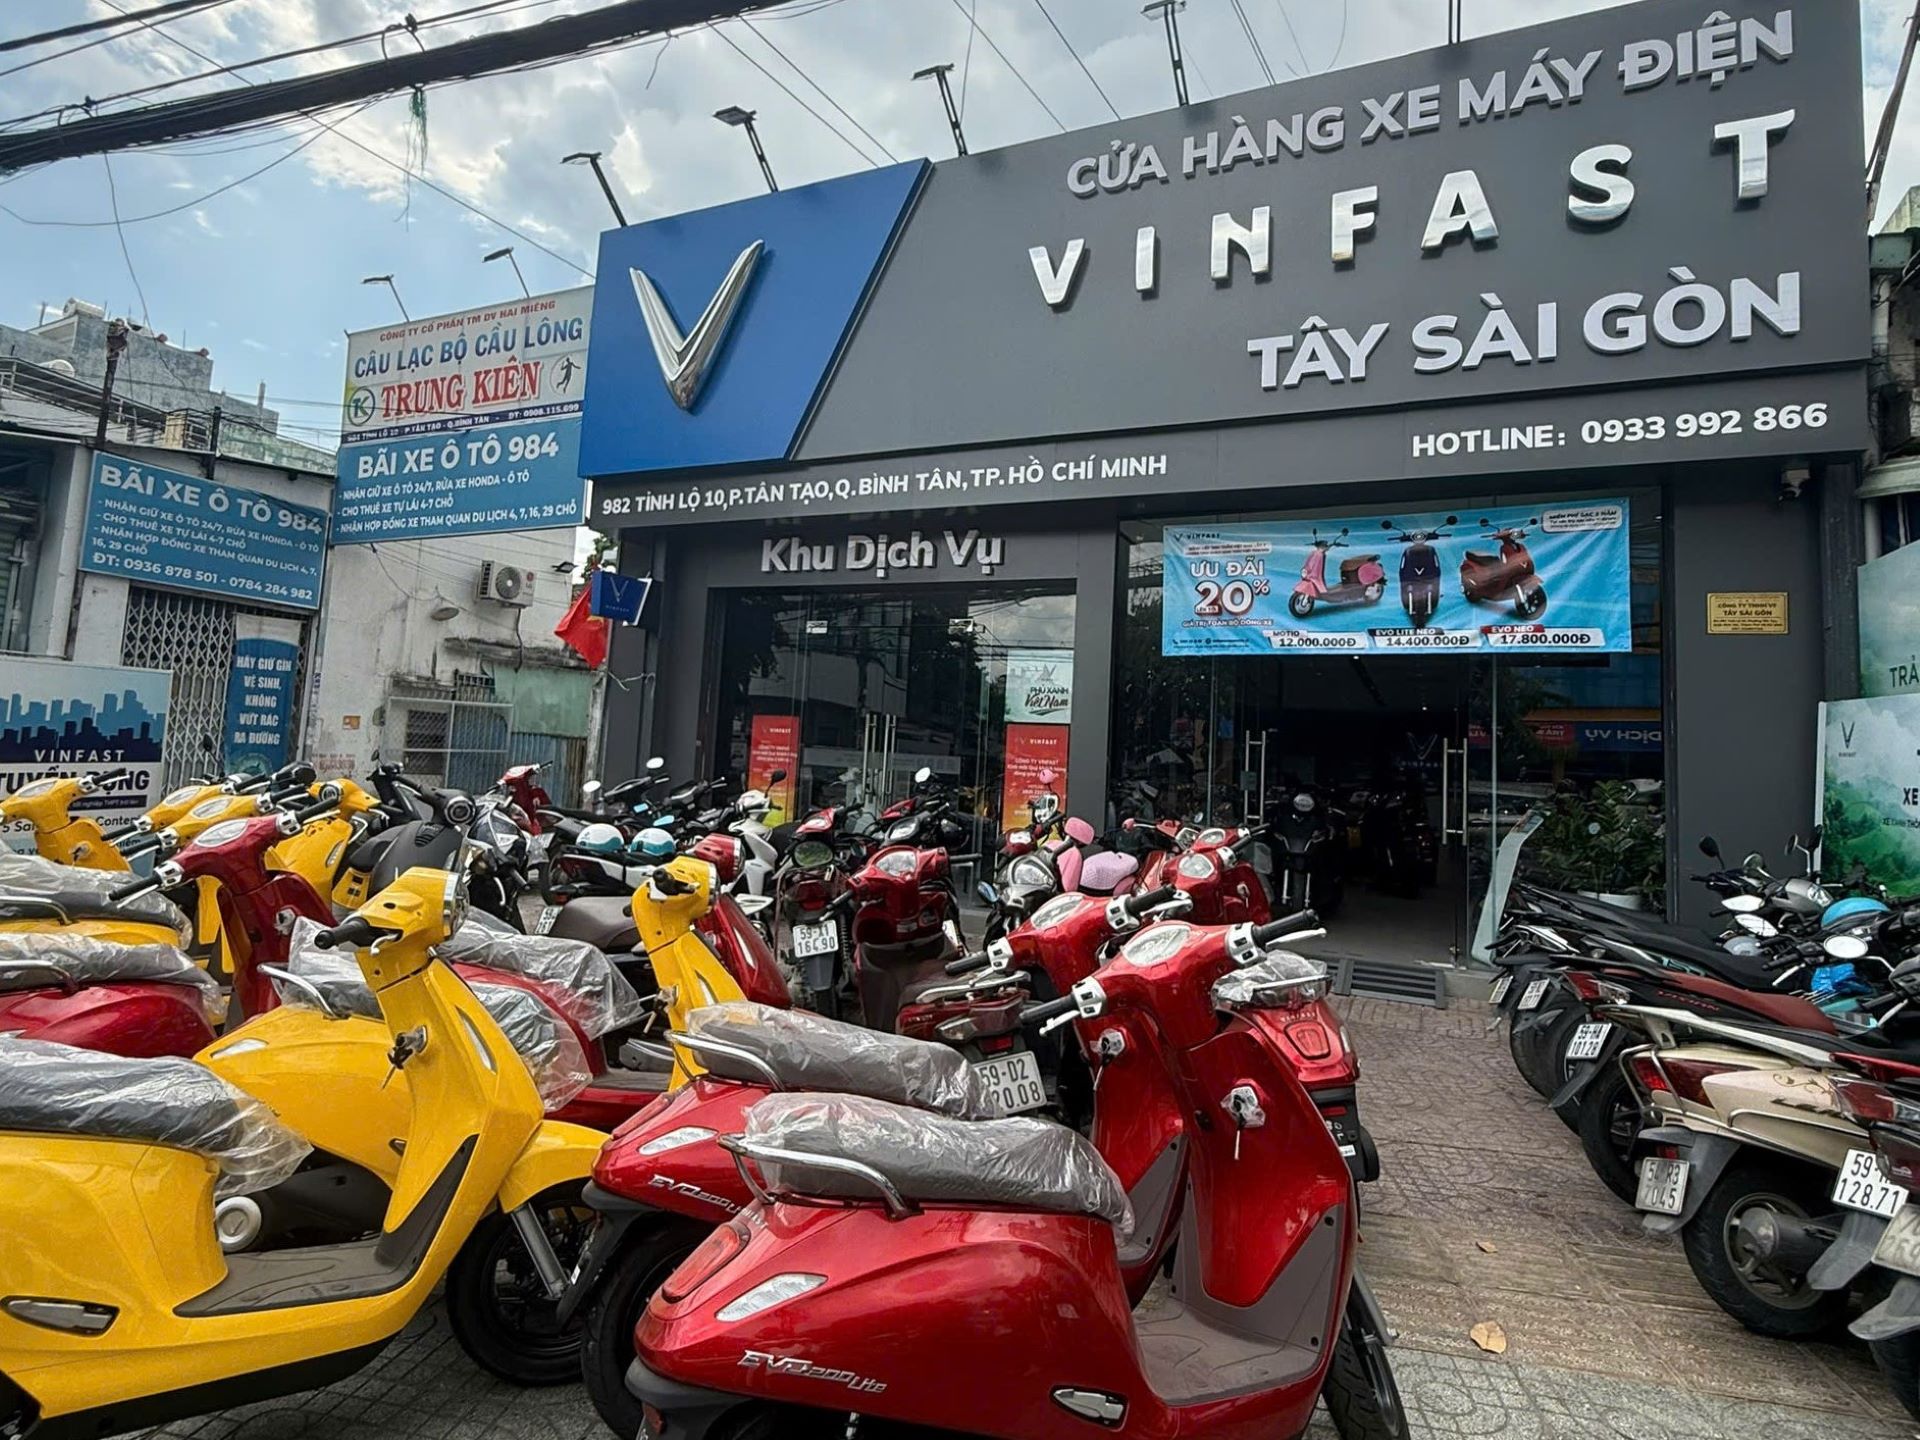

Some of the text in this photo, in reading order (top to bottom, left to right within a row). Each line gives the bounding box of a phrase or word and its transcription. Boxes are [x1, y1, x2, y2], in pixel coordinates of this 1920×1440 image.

[1067, 10, 1793, 198] CỬA HÀNG XE MÁY ĐIỆN
[1029, 109, 1796, 306] VINFAST
[408, 327, 418, 336] TY
[467, 315, 481, 325] TM
[1247, 266, 1800, 390] TÂY SÀI GÒN
[355, 317, 582, 378] CÂU LẠC BỘ CẦU LÔNG
[381, 355, 541, 419] TRUNG KIÊN
[1412, 402, 1828, 457] HOTLINE: 0933 992 866
[358, 432, 559, 479] BÃI XE Ô TÔ 984
[100, 464, 322, 534] BÃI XE Ô TÔ 984
[381, 485, 392, 496] XE
[455, 478, 466, 489] XE
[468, 475, 500, 487] HONDA
[601, 454, 1167, 515] 982 TỈNH LỘ CHÍ MINH
[104, 499, 137, 514] NHẬN
[160, 512, 174, 521] XE
[186, 516, 200, 527] TÔ
[247, 530, 260, 541] XE
[262, 533, 293, 547] HONDA
[341, 507, 359, 517] CHO
[381, 503, 392, 513] XE
[420, 499, 434, 509] 4-7
[407, 517, 419, 527] XE
[420, 515, 444, 526] THAM
[445, 512, 470, 526] QUAN
[472, 512, 486, 522] DU
[487, 509, 508, 523] LỊCH
[519, 508, 528, 520] 7,
[529, 507, 541, 519] 16,
[542, 505, 554, 517] 29
[103, 512, 128, 524] CHO
[160, 525, 174, 534] XE
[208, 533, 224, 544] 4-7
[109, 540, 122, 550] 29
[193, 544, 206, 554] XE
[208, 546, 235, 560] THAM
[237, 553, 264, 566] QUAN
[265, 558, 279, 568] DU
[280, 561, 299, 573] LỊCH
[761, 530, 1002, 577] Khu Dịch Vụ
[92, 552, 313, 600] ĐT: 0936 878 501 0784 284 982
[1190, 556, 1264, 577] ƯU ĐÃI
[1279, 637, 1356, 647] 12.000.000Đ
[1387, 635, 1470, 646] 14.400.000Đ
[1491, 625, 1535, 633] EVO NEO
[1500, 634, 1591, 645] 17.800.000Đ
[245, 694, 277, 708] KHÔNG
[34, 749, 125, 762] VINFAST
[1839, 1178, 1901, 1214] 128.71
